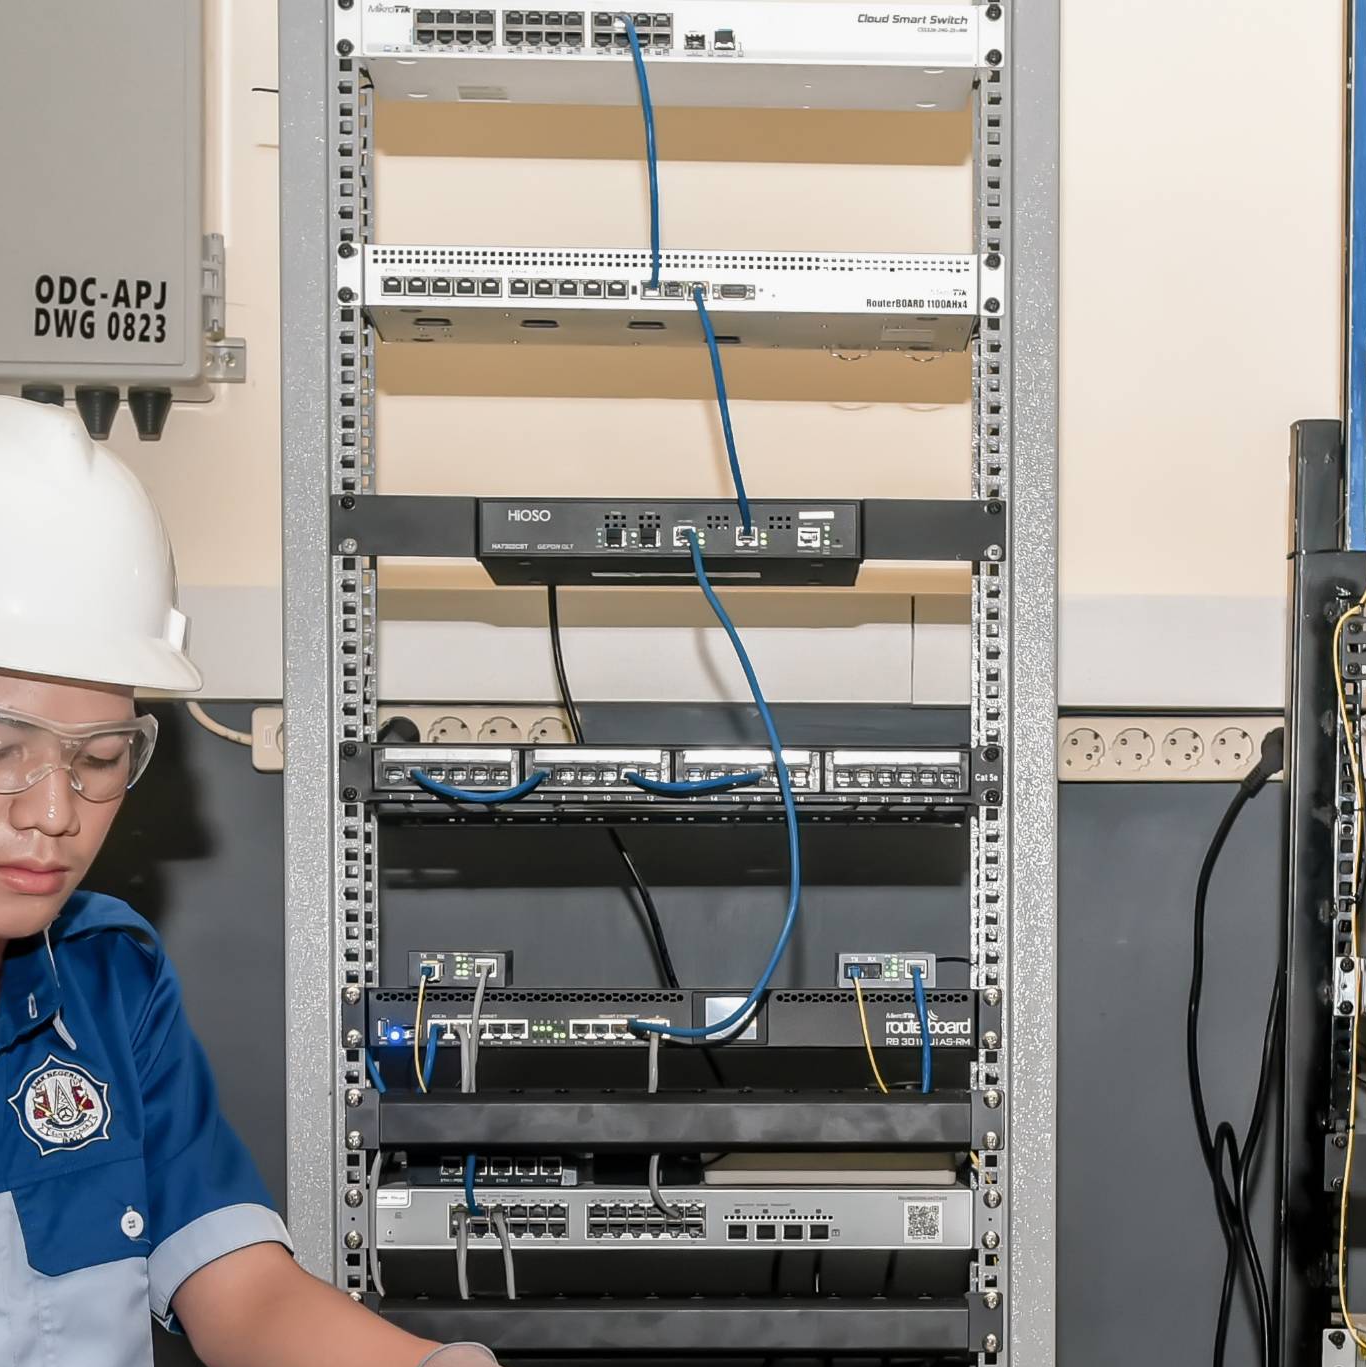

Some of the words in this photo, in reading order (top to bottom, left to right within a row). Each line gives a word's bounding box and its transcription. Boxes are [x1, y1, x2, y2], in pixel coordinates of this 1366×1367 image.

[858, 14, 889, 23] Cloud
[892, 15, 927, 24] Smart
[930, 15, 968, 25] Switch
[35, 274, 168, 310] ODC-APJ
[866, 298, 925, 308] RouterBOARD
[927, 299, 968, 309] 1100AHx4
[34, 307, 96, 340] DWG
[106, 311, 168, 343] 0823
[975, 773, 987, 782] Cat
[988, 773, 999, 782] 5e
[885, 1017, 971, 1034] routeboard
[886, 1037, 899, 1046] RB
